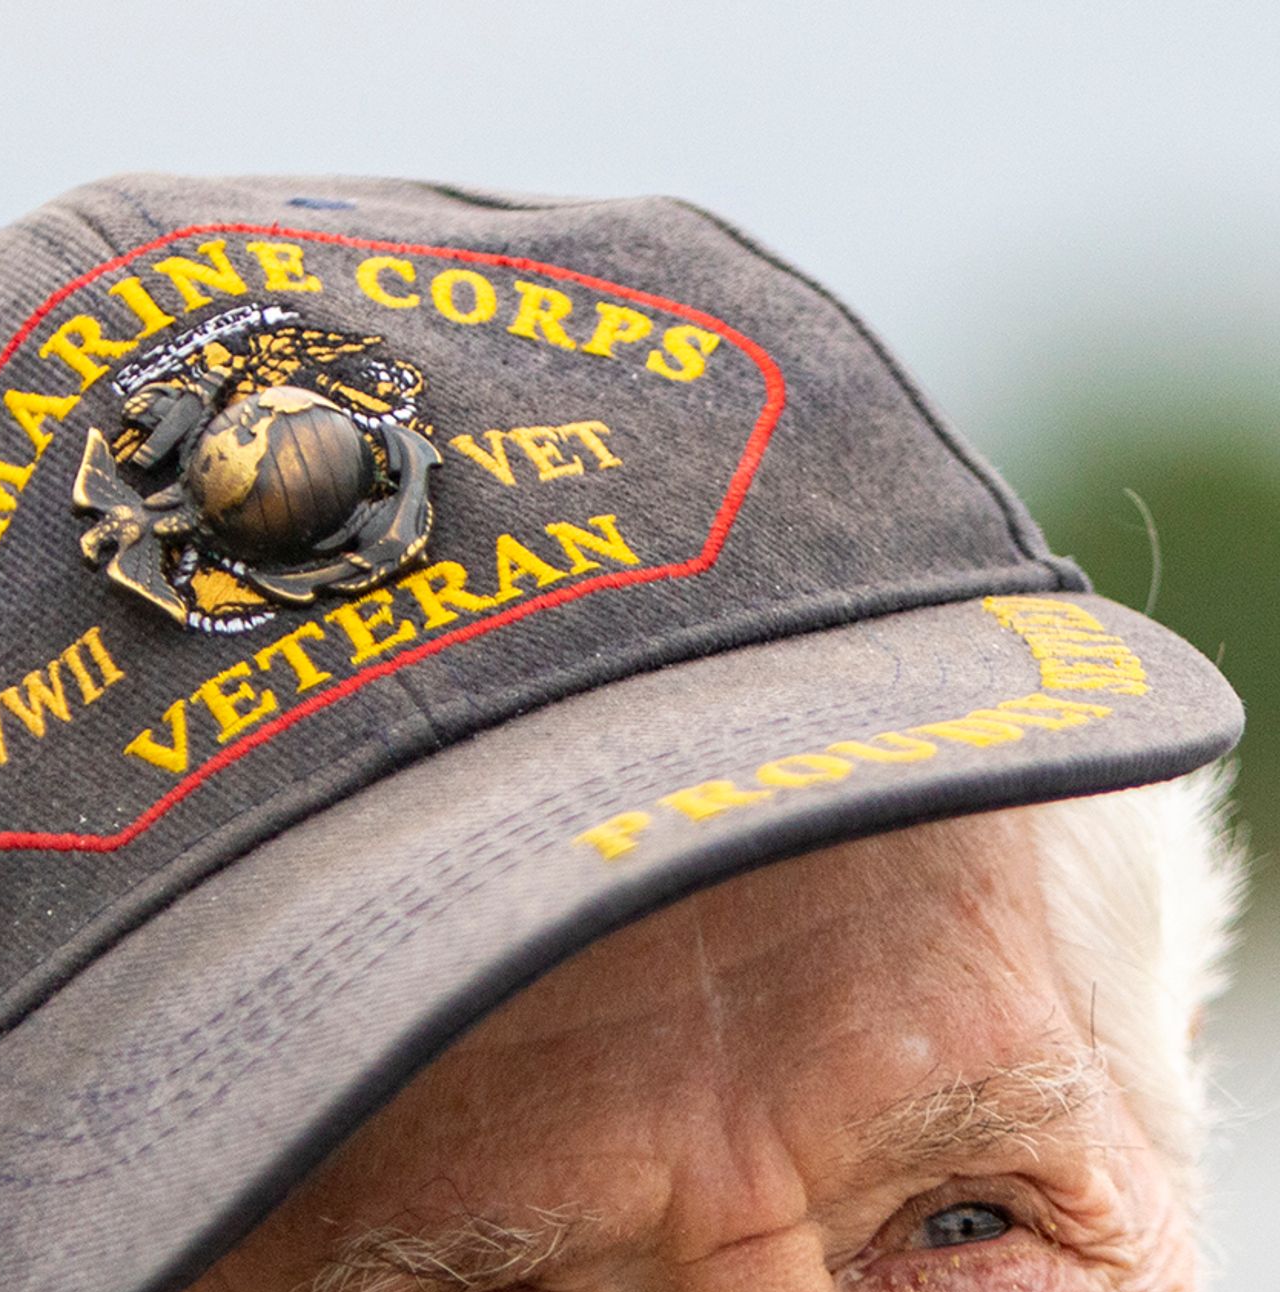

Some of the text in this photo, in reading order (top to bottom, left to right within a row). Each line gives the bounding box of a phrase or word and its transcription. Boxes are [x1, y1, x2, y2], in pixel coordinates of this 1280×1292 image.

[356, 255, 720, 383] CORPS
[449, 421, 622, 487] VET
[123, 514, 640, 774] VETERAN
[574, 693, 1112, 860] PROUDLY
